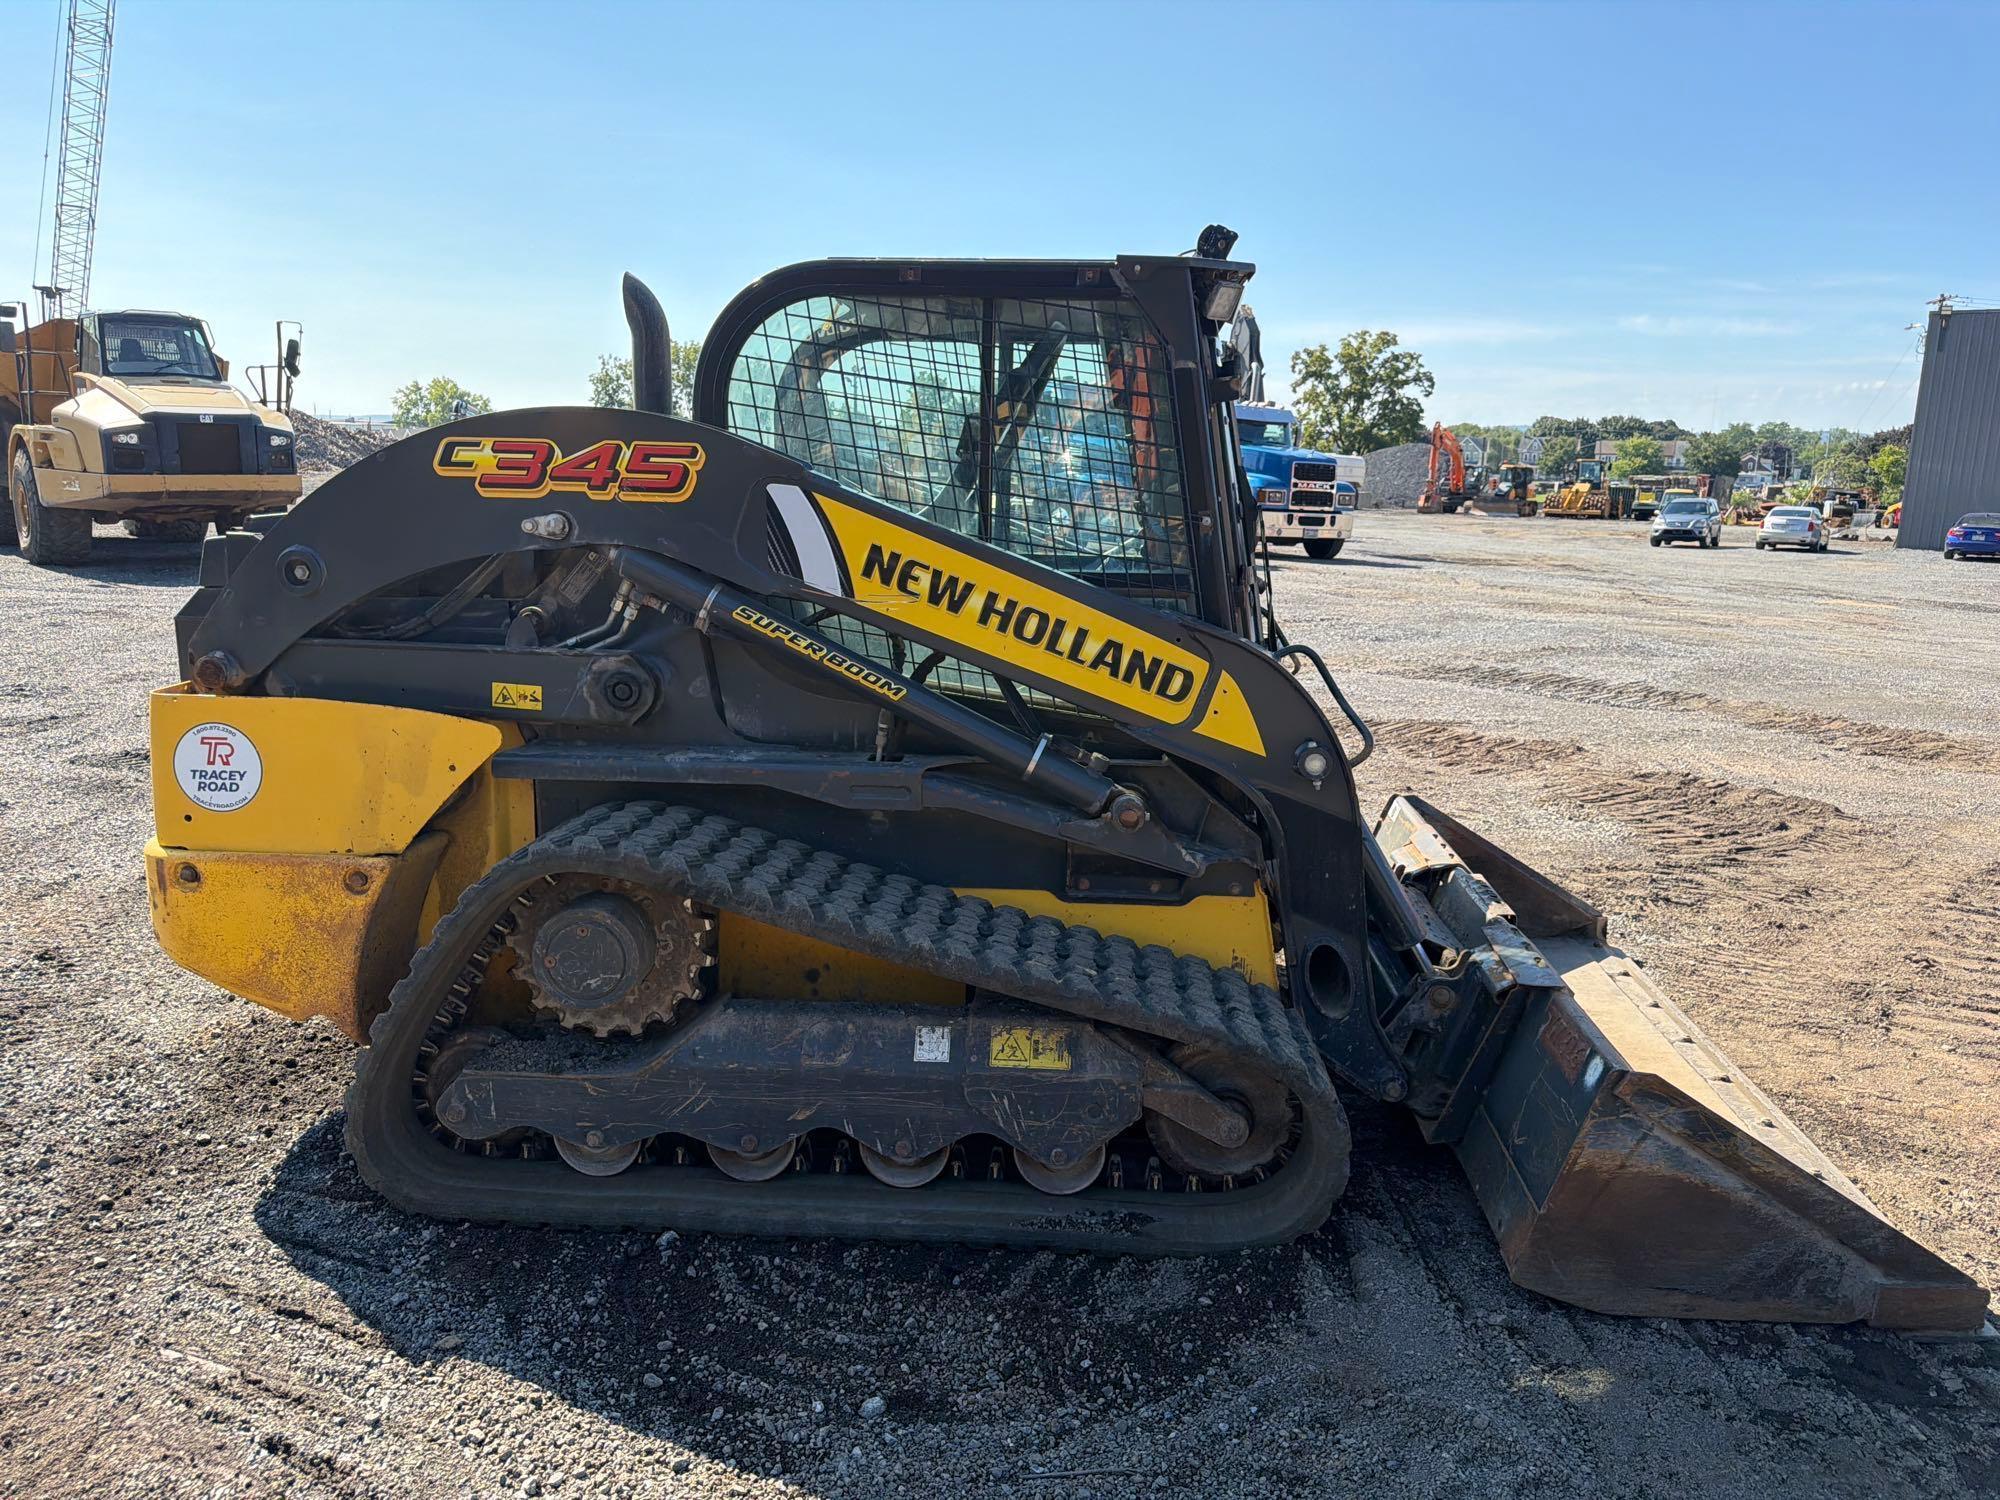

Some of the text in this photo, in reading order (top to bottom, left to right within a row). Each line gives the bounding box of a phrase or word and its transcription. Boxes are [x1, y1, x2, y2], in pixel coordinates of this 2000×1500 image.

[200, 414, 214, 423] CAT
[433, 437, 705, 502] C345
[1297, 482, 1331, 490] MACK
[860, 543, 1196, 704] NEW HOLLAND
[732, 605, 907, 700] SUPER BOOM
[190, 769, 248, 781] TRACEY
[197, 781, 240, 792] ROAD
[192, 794, 249, 809] TRACEYROAD.COM
